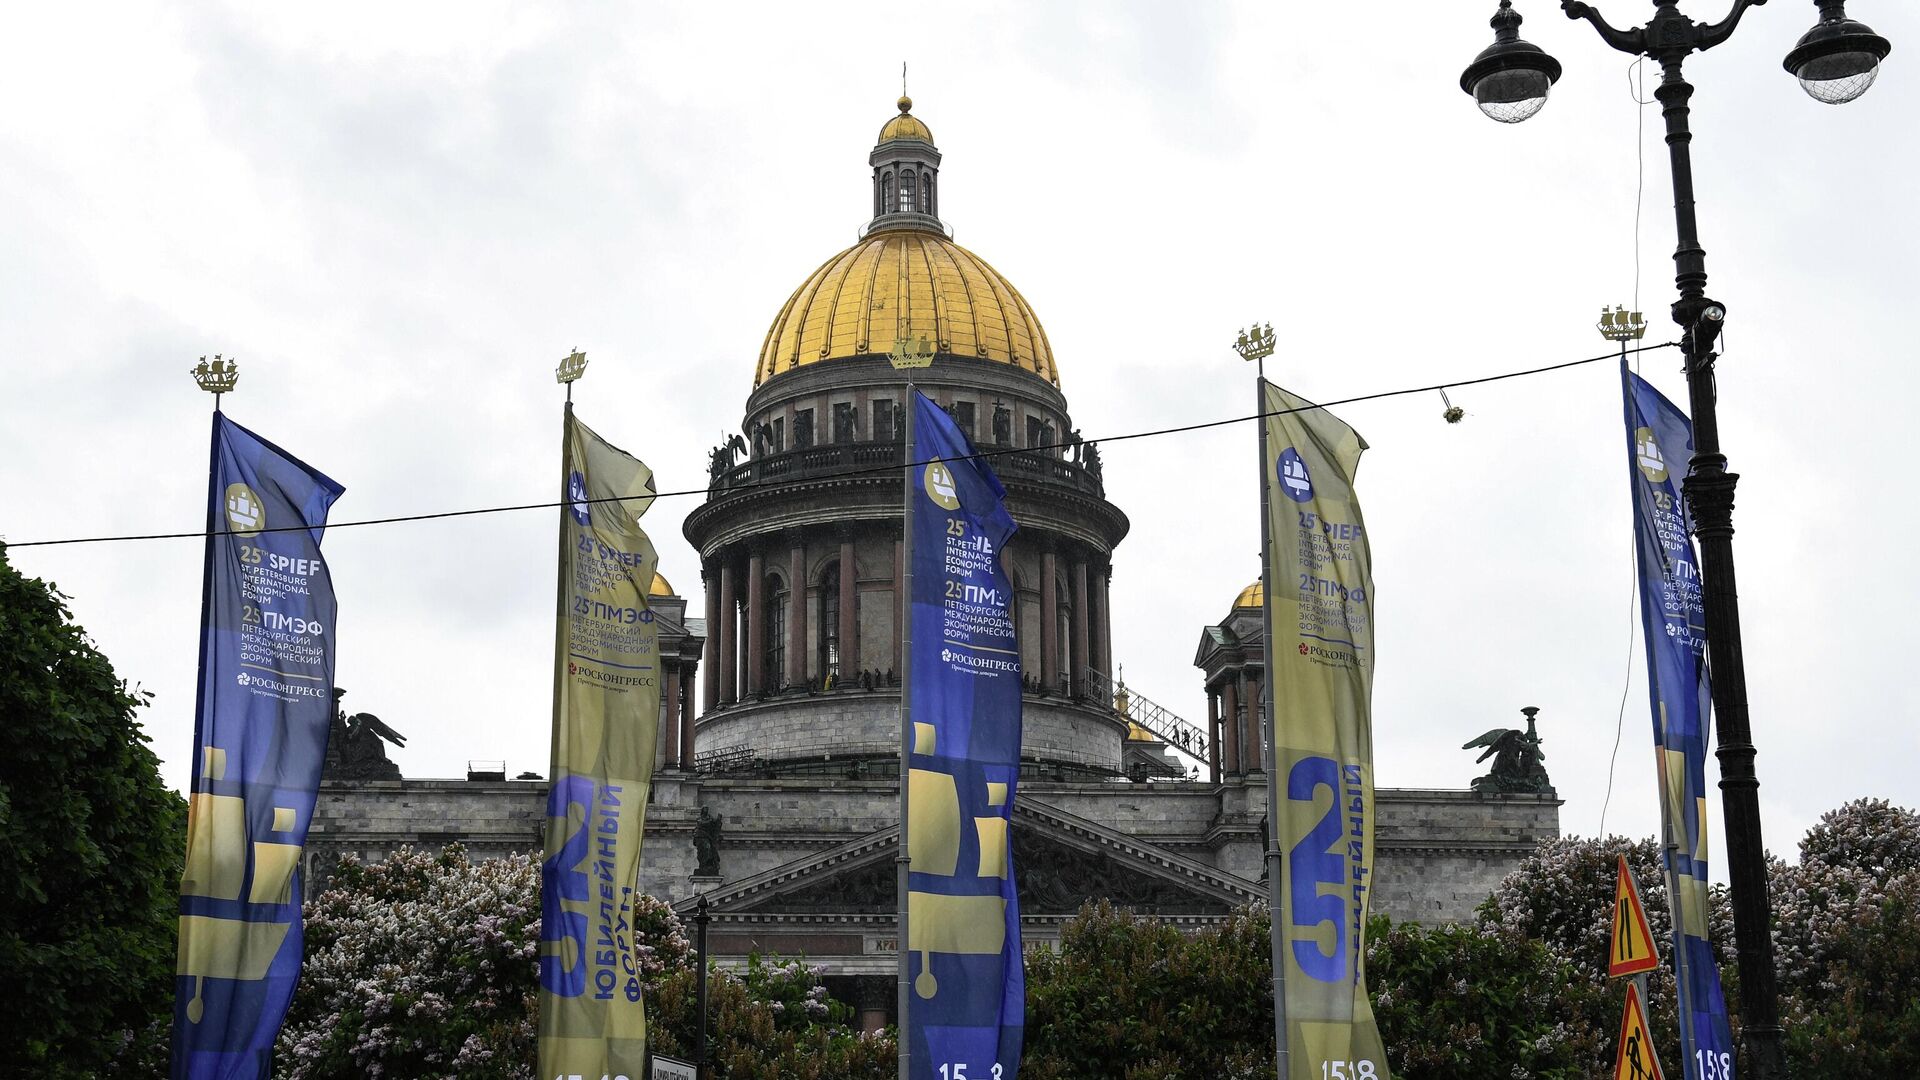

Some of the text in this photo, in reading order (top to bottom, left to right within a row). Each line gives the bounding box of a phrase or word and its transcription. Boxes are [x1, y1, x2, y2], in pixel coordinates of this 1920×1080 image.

[1653, 490, 1672, 510] 25
[269, 553, 321, 577] SPIEF
[945, 555, 989, 572] ECONOMIC
[945, 565, 973, 578] FORUM
[242, 573, 311, 595] INTERNATIONAL
[253, 566, 307, 586] PETERSBURG
[576, 571, 616, 590] ECONOMIC
[242, 581, 287, 600] ECONOMIC
[242, 590, 272, 604] FORUM
[575, 580, 601, 595] FORUM
[242, 605, 323, 637] 25 ПМЭФ
[594, 602, 655, 625] ПМЭФ
[241, 623, 311, 646] ПЕТЕРБУРГСКИЙ
[571, 623, 654, 645] МЕЖДУНАРОДНЫЙ
[572, 613, 641, 636] ПЕТЕРБУРГСКИЙ
[943, 628, 970, 641] ФОРУМ
[241, 633, 324, 656] МЕЖДУНАРОДНЫЙ
[241, 642, 321, 665] ЭКОНОМИЧЕСКИЙ
[569, 642, 599, 656] ФОРУМ
[570, 633, 651, 654] ЭКОНОМИЧЕСКИЙ
[240, 652, 272, 666] ФОРУМ
[952, 652, 1021, 672] РОСКОНГРЕСС
[251, 676, 325, 698] РОСКОНГРЕСС
[578, 666, 654, 687] РОСКОНГРЕСС
[593, 784, 623, 1000] ЮБИЛЕЙНЫЙ
[614, 886, 641, 1003] ФОРУМ
